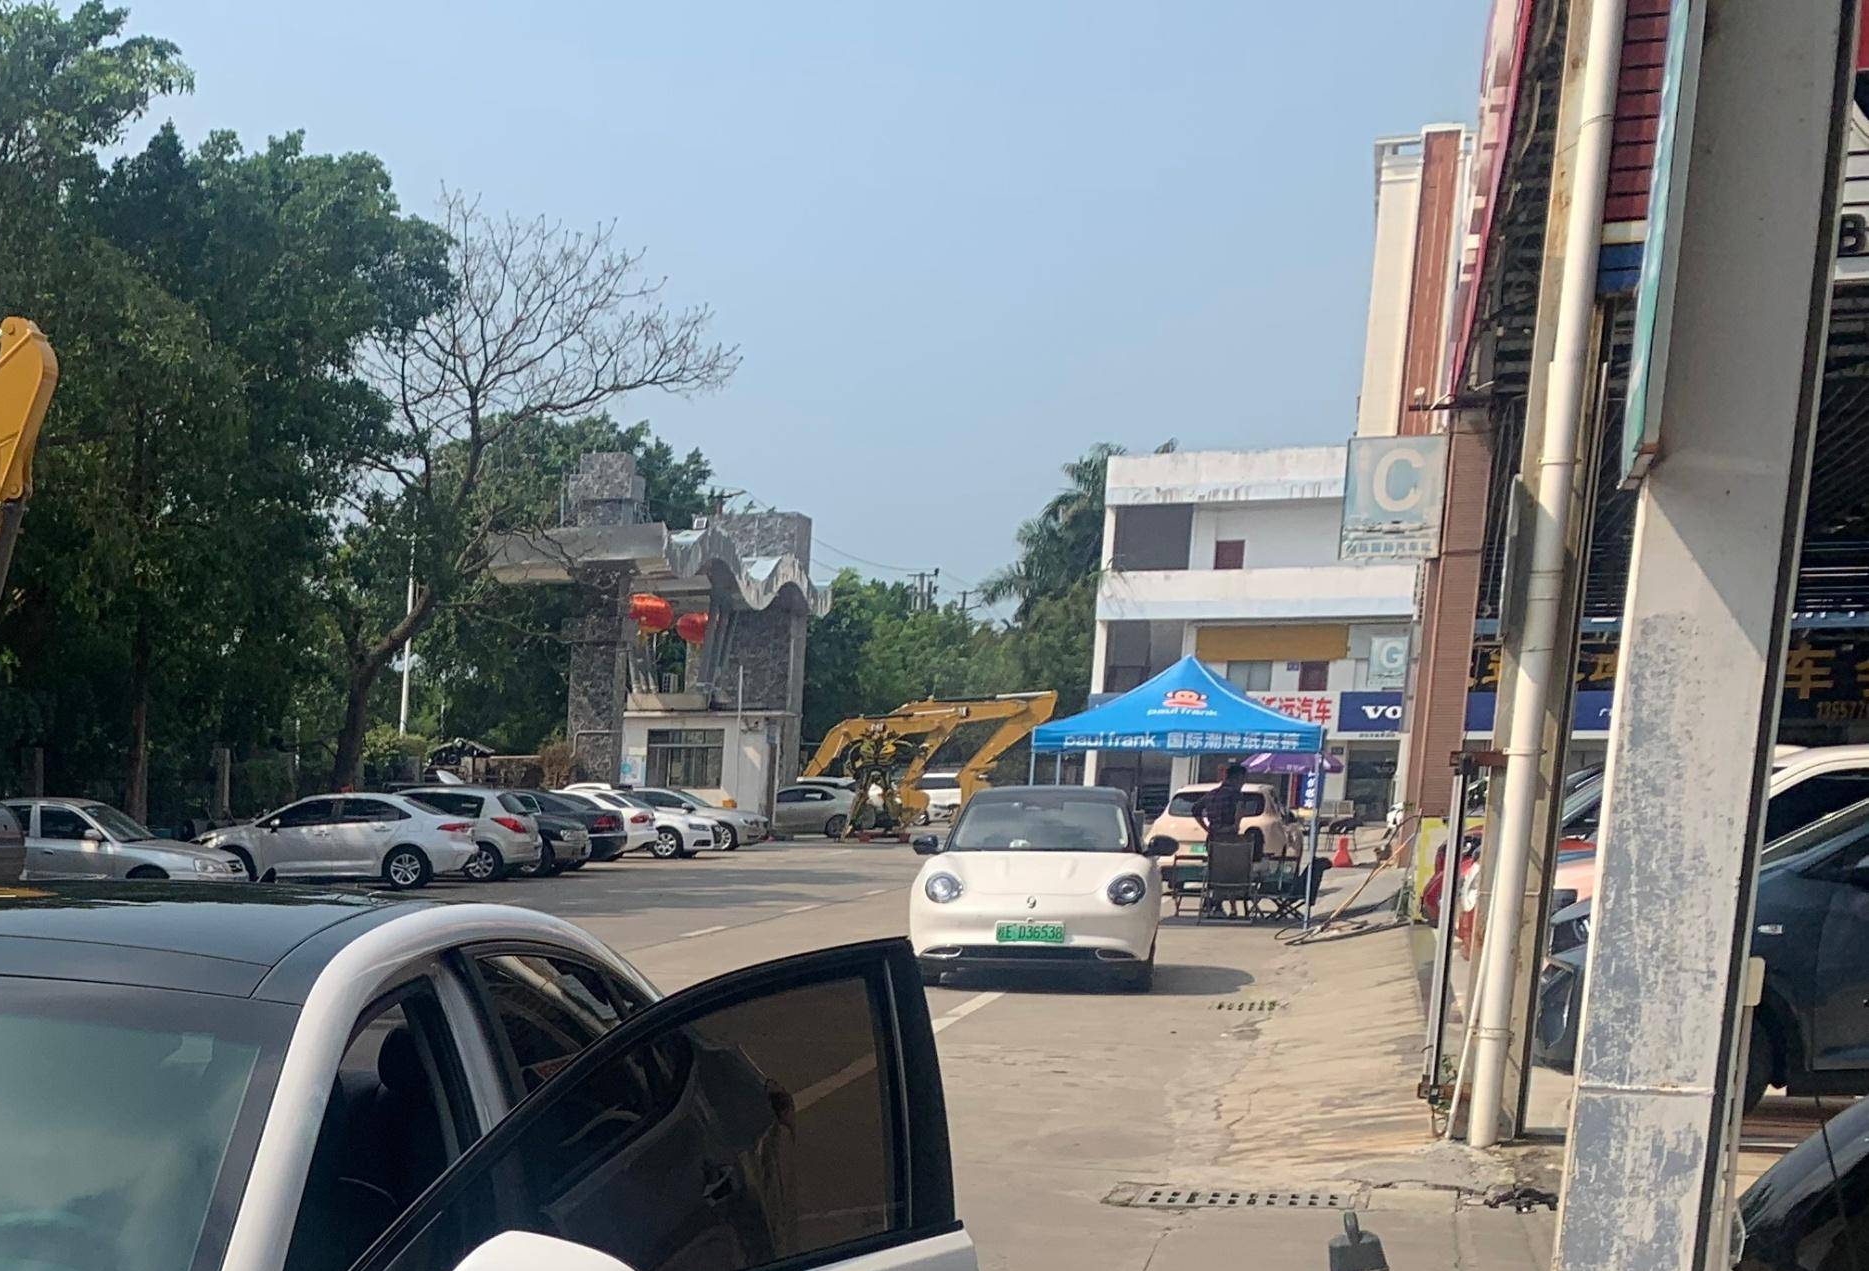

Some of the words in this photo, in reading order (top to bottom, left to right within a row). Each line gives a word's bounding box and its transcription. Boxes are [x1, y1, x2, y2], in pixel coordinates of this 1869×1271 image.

[1373, 447, 1426, 513] C
[1381, 640, 1404, 669] G
[1062, 732, 1104, 748] paul
[1107, 731, 1157, 748] frank
